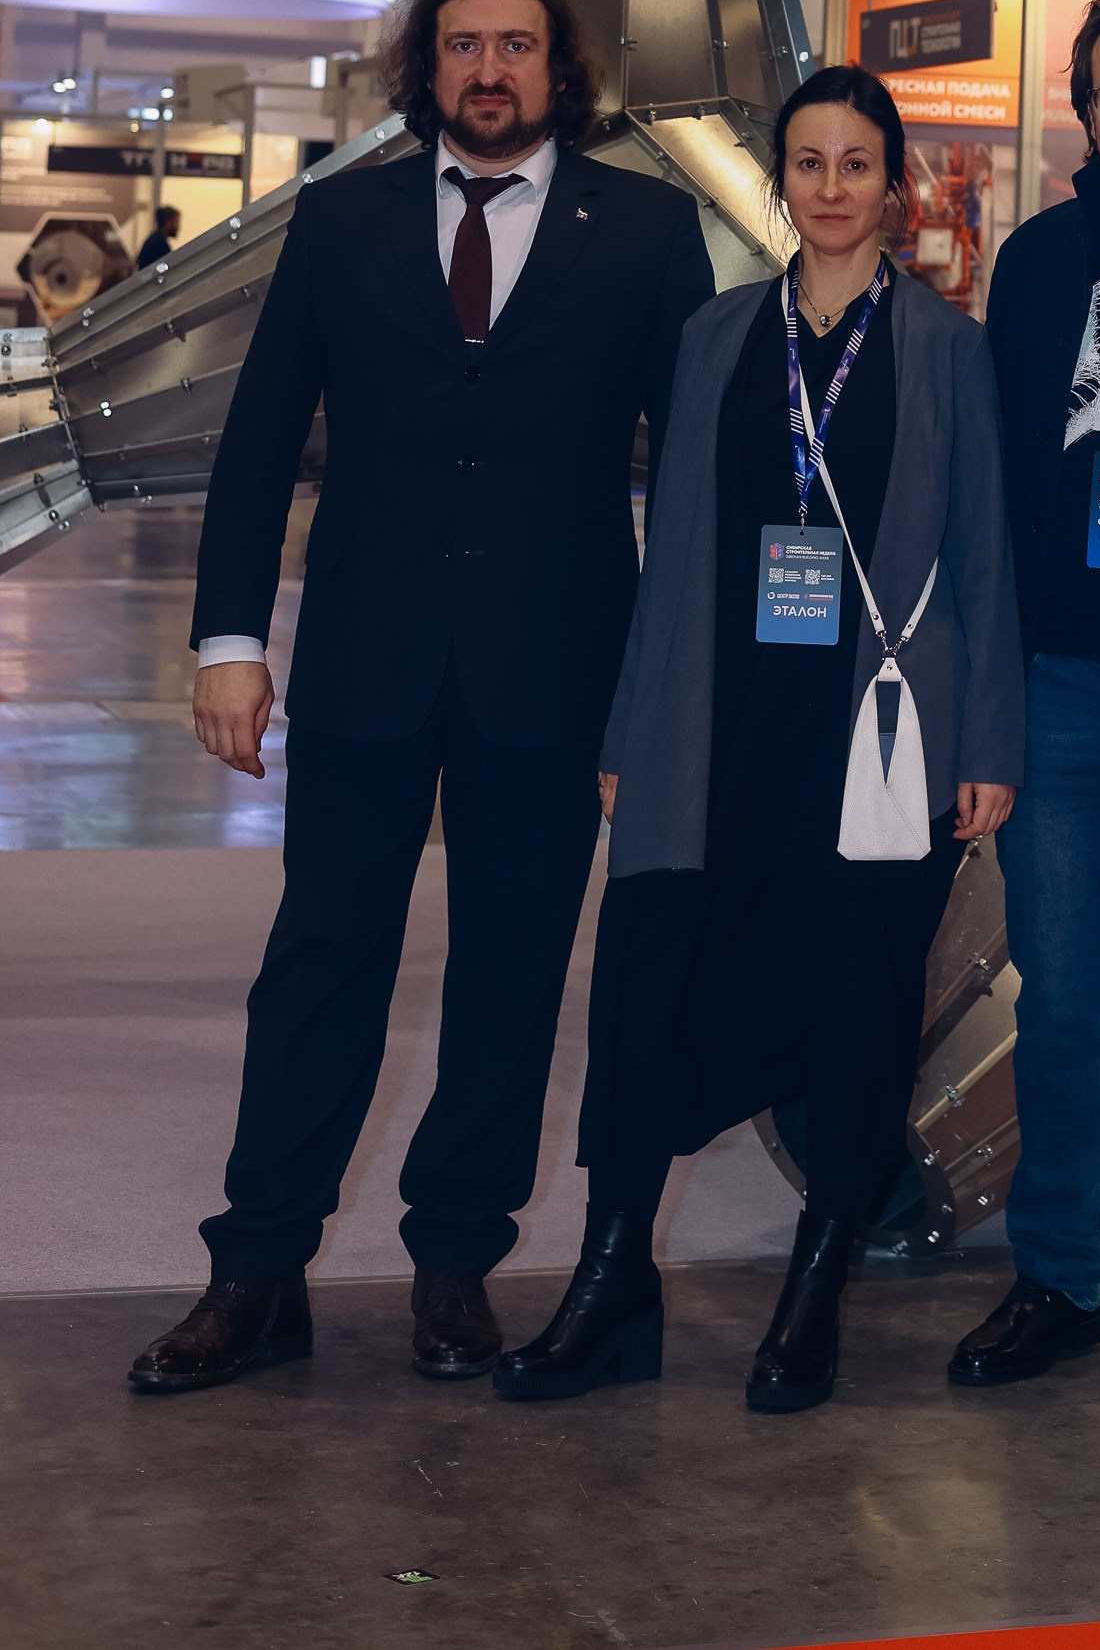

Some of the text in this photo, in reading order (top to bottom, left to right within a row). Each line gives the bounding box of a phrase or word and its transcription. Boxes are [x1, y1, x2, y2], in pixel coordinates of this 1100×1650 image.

[947, 81, 1011, 98] ПОДАЧА
[953, 103, 1006, 120] СМЕСИ
[773, 605, 827, 618] ЭТАЛОН
